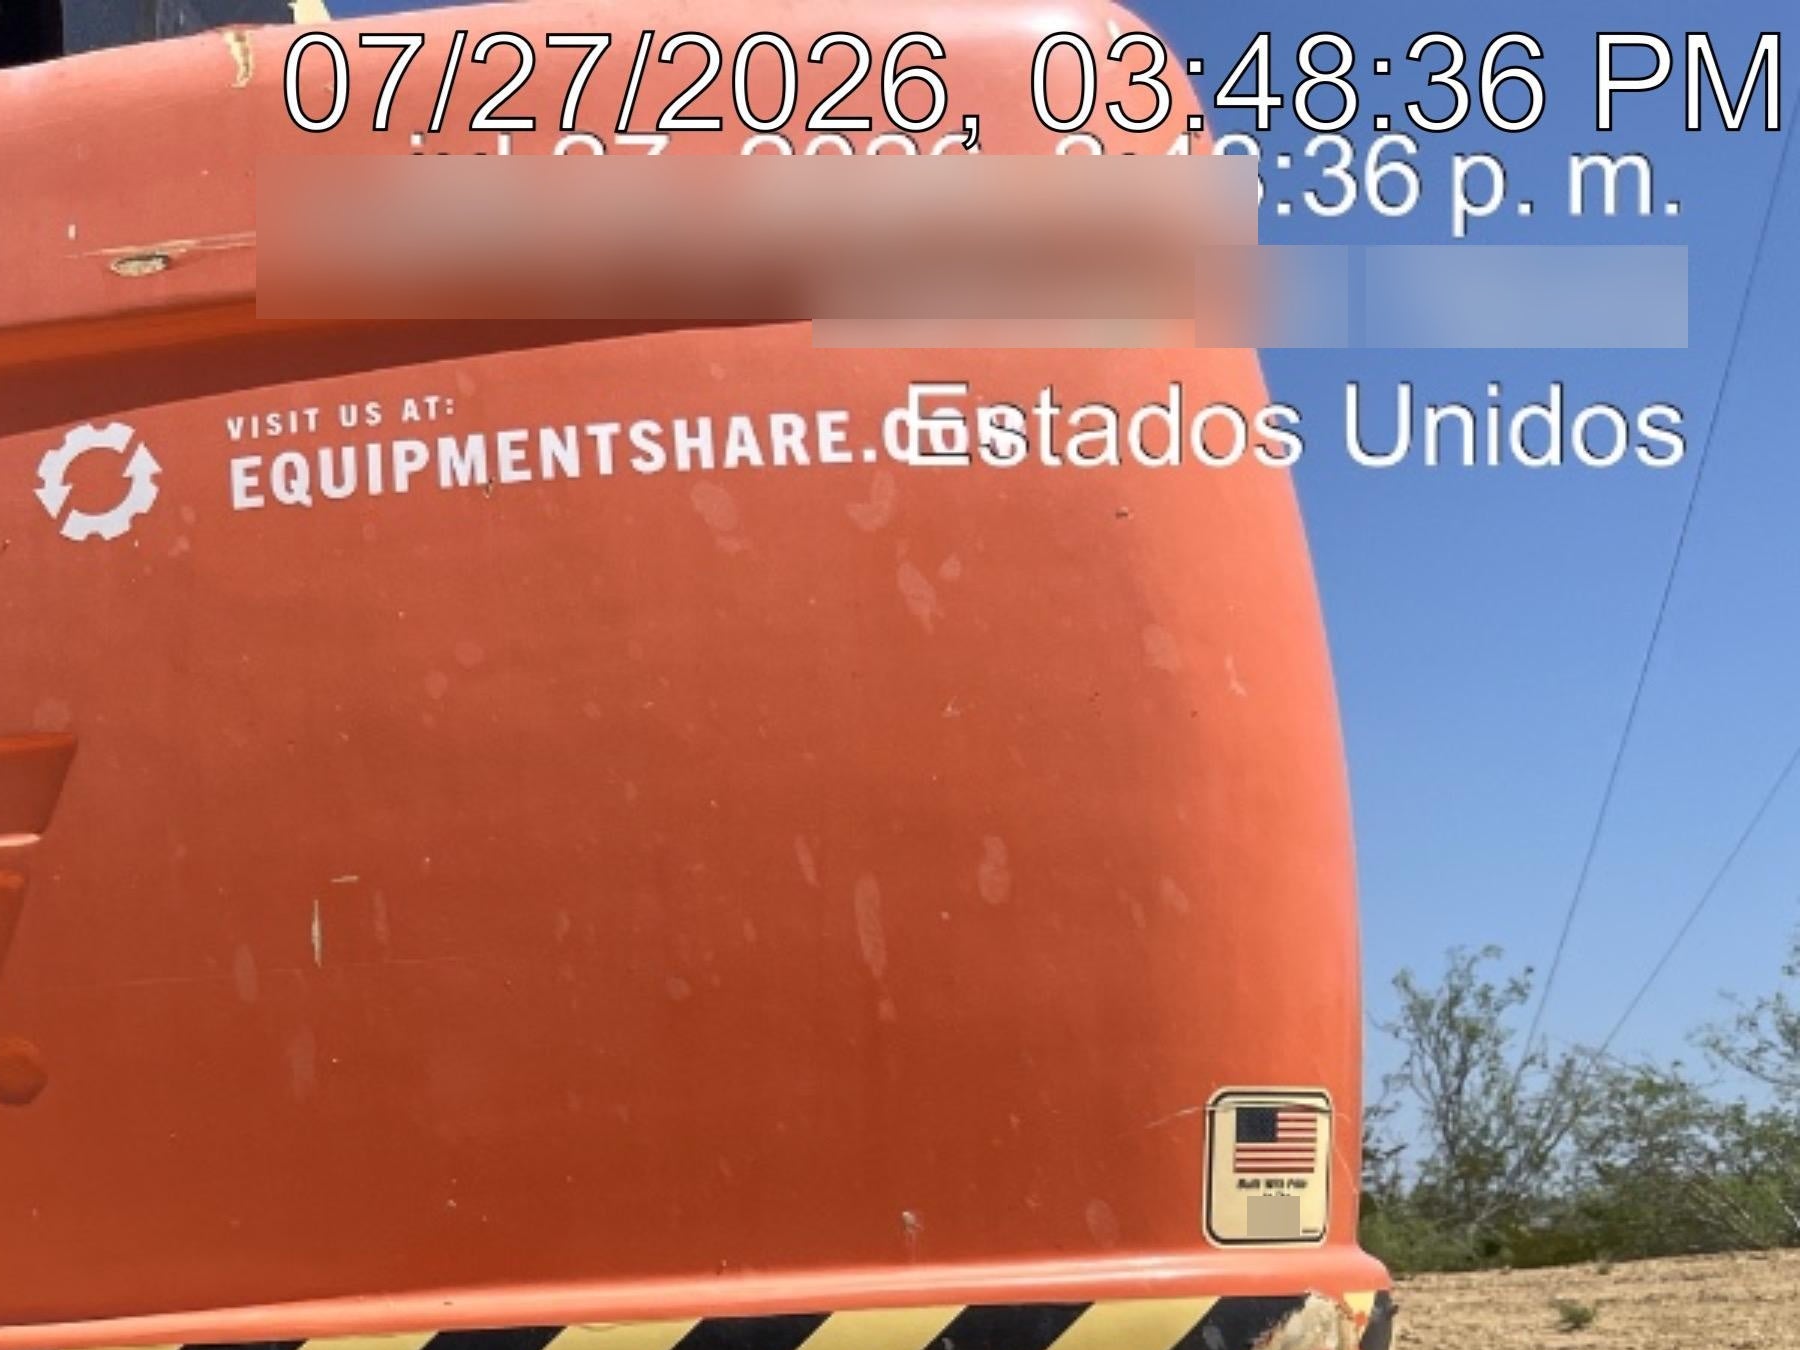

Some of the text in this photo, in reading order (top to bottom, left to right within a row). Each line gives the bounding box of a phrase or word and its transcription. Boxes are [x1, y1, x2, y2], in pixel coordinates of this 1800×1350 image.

[227, 396, 455, 441] VISIT US AT:
